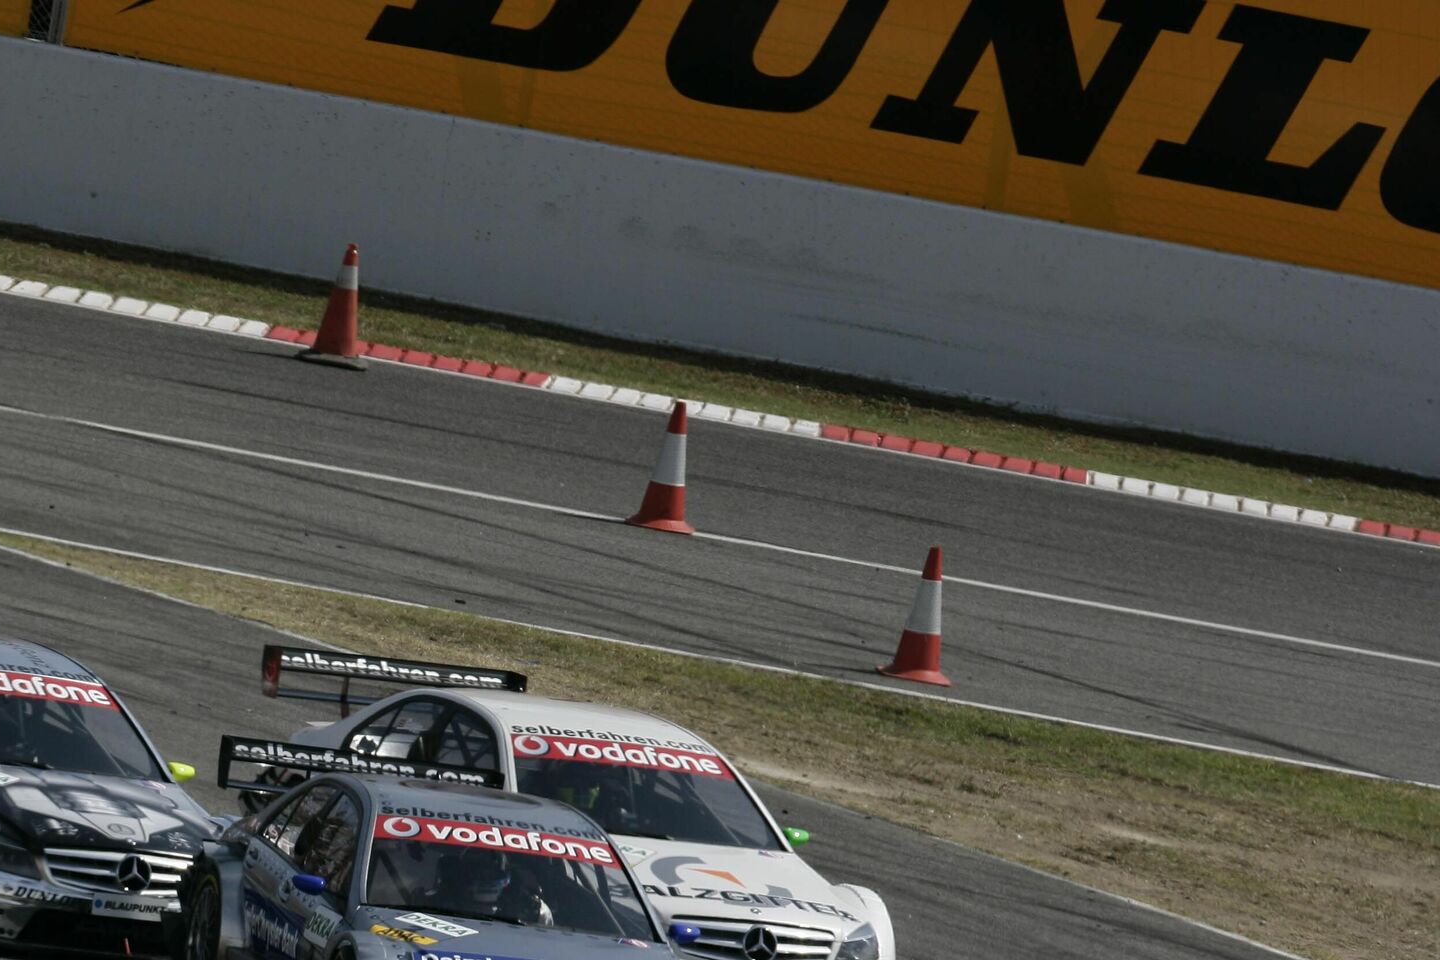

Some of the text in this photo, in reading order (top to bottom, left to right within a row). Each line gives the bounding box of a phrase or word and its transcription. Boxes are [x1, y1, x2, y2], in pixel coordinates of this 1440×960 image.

[511, 723, 713, 755] selberfahren.com
[553, 739, 723, 776] vodafone
[380, 803, 606, 842] selberfahren.com
[426, 825, 614, 864] vodafone
[13, 885, 79, 907] DUNLOP
[103, 899, 167, 915] BLAUPUNKT
[306, 912, 336, 940] DEKRA
[402, 912, 469, 937] DEKRA
